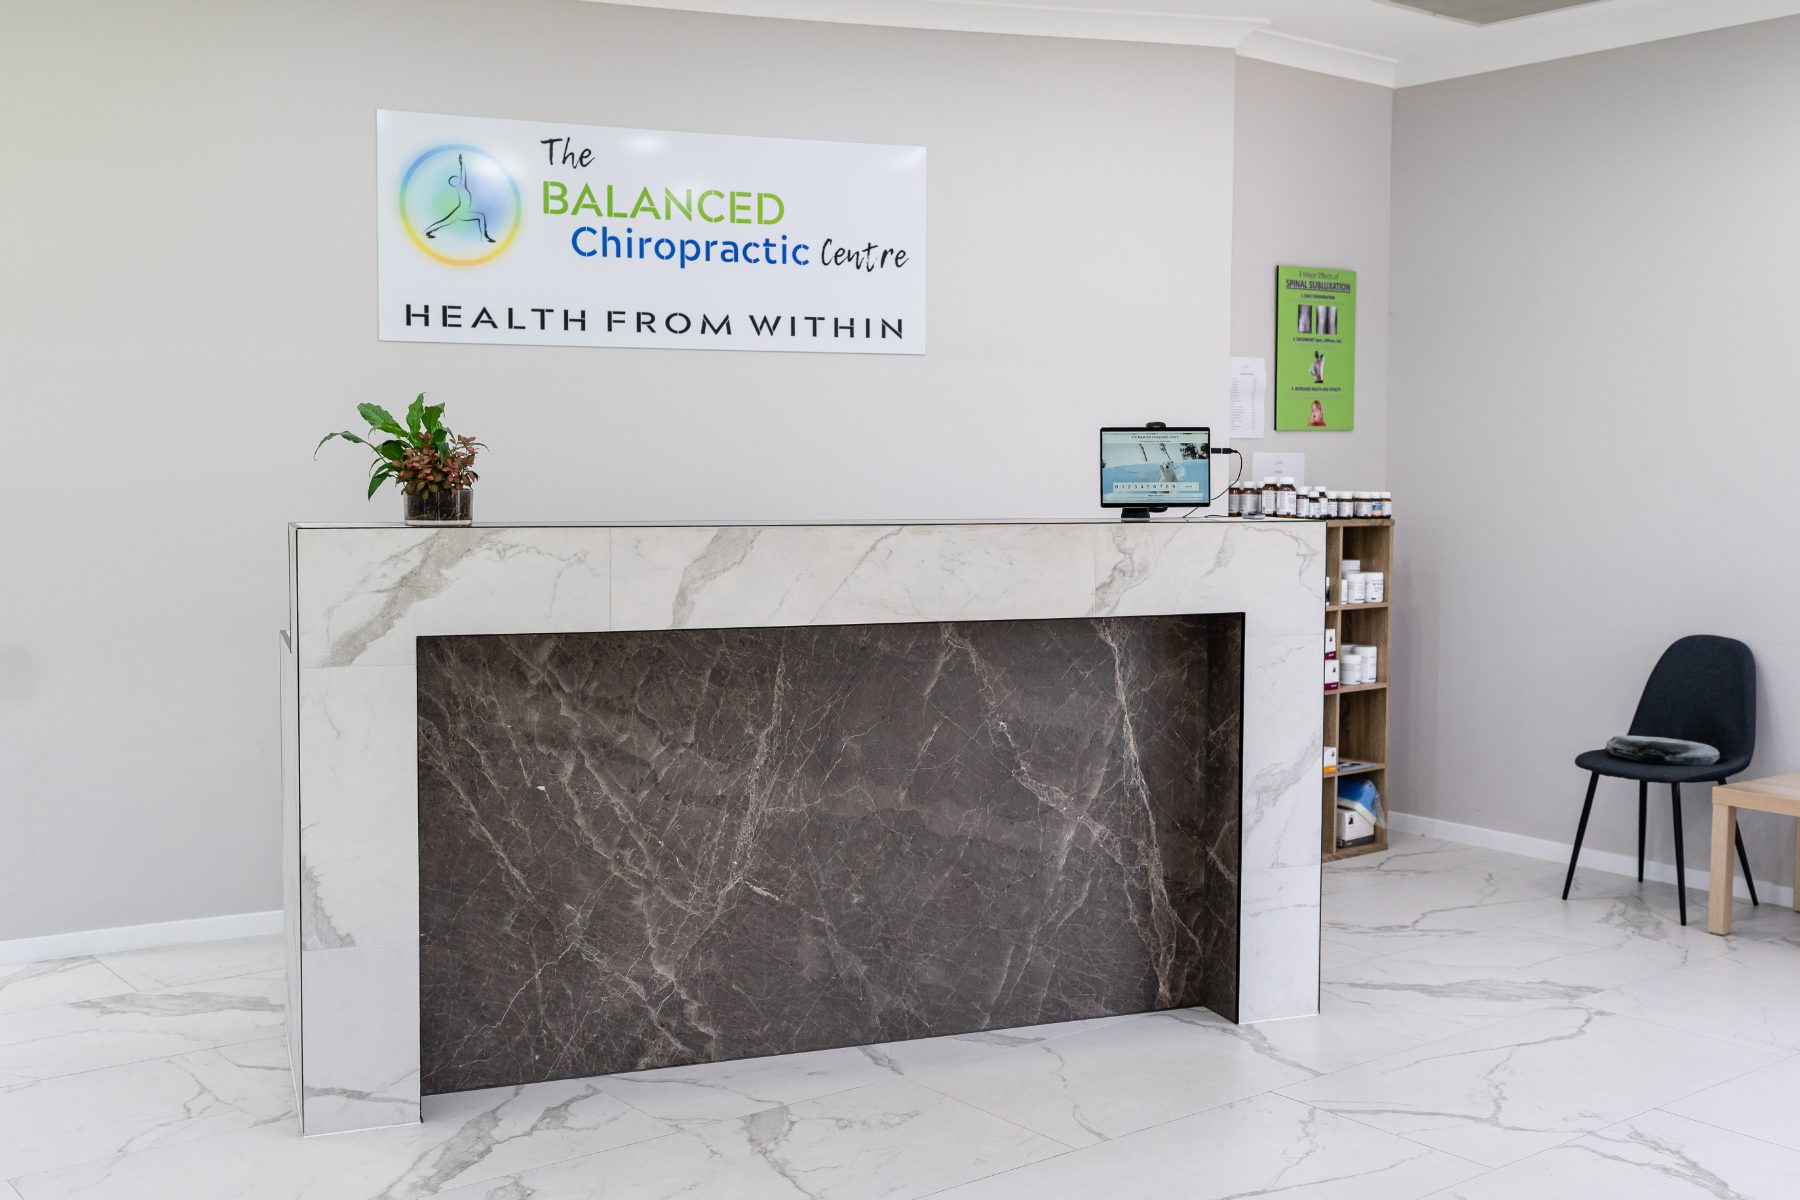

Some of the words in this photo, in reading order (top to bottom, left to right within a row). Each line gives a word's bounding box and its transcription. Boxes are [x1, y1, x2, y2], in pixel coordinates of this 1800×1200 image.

[540, 136, 595, 169] The
[542, 180, 786, 226] BALANCED
[571, 225, 811, 270] Chiropractic
[820, 236, 910, 273] Centre
[1286, 279, 1308, 288] SPINAL
[1309, 280, 1351, 291] SUBLUXATION
[1303, 271, 1317, 279] Major
[1318, 271, 1333, 279] Effects
[405, 303, 588, 332] HEALTH
[606, 310, 733, 336] FROM
[748, 315, 904, 340] WITHIN
